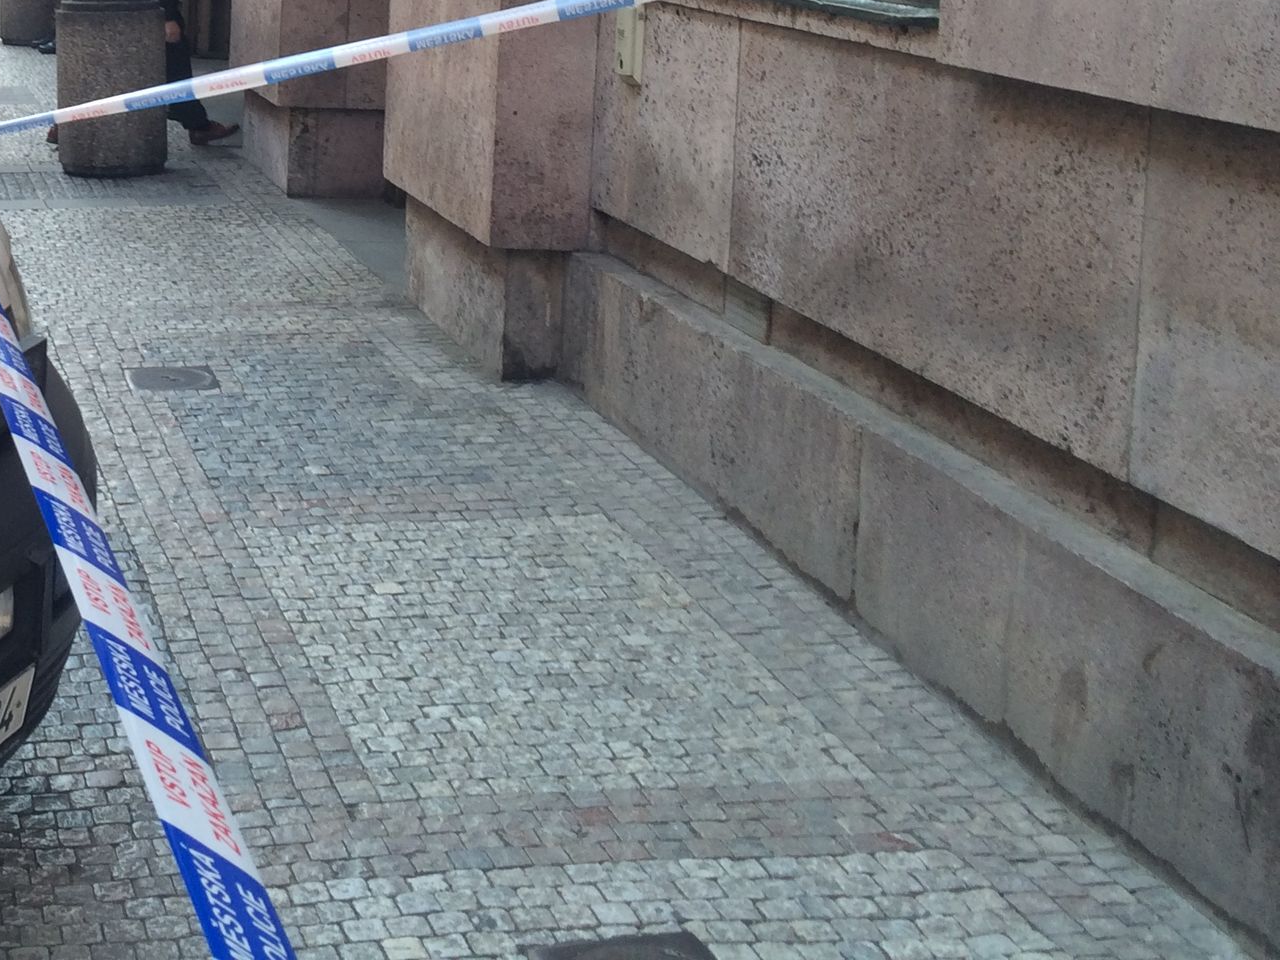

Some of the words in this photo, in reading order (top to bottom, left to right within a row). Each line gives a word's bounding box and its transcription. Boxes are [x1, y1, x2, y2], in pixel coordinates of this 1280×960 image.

[46, 495, 88, 558] MĚSTSKÁ
[80, 520, 118, 575] POLICIE
[76, 567, 112, 616] VSTUP
[97, 633, 156, 721] MĚSTSKÁ
[142, 665, 191, 739] POLICIE
[145, 739, 192, 809] VSTUP
[179, 751, 242, 857] ZAKÁZÁN
